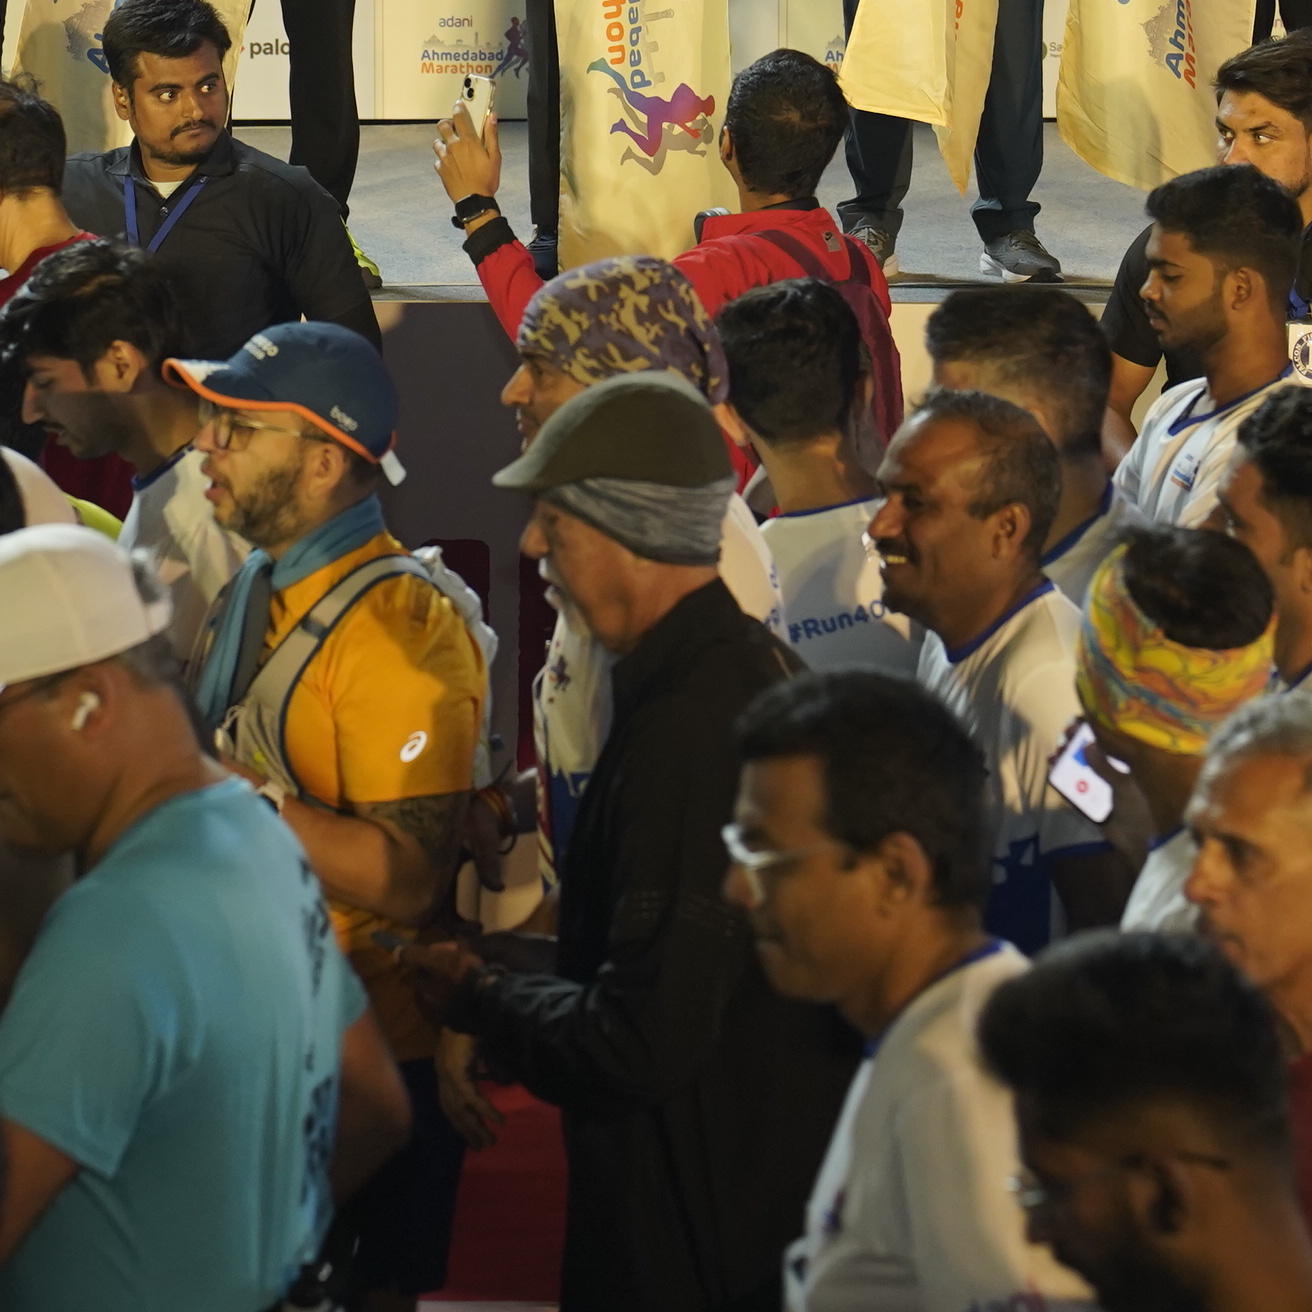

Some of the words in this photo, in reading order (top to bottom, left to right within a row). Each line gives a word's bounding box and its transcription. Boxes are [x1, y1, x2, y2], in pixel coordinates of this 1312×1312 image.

[438, 15, 474, 29] adani
[420, 48, 505, 63] Ahmedabad
[420, 62, 493, 75] Marathon
